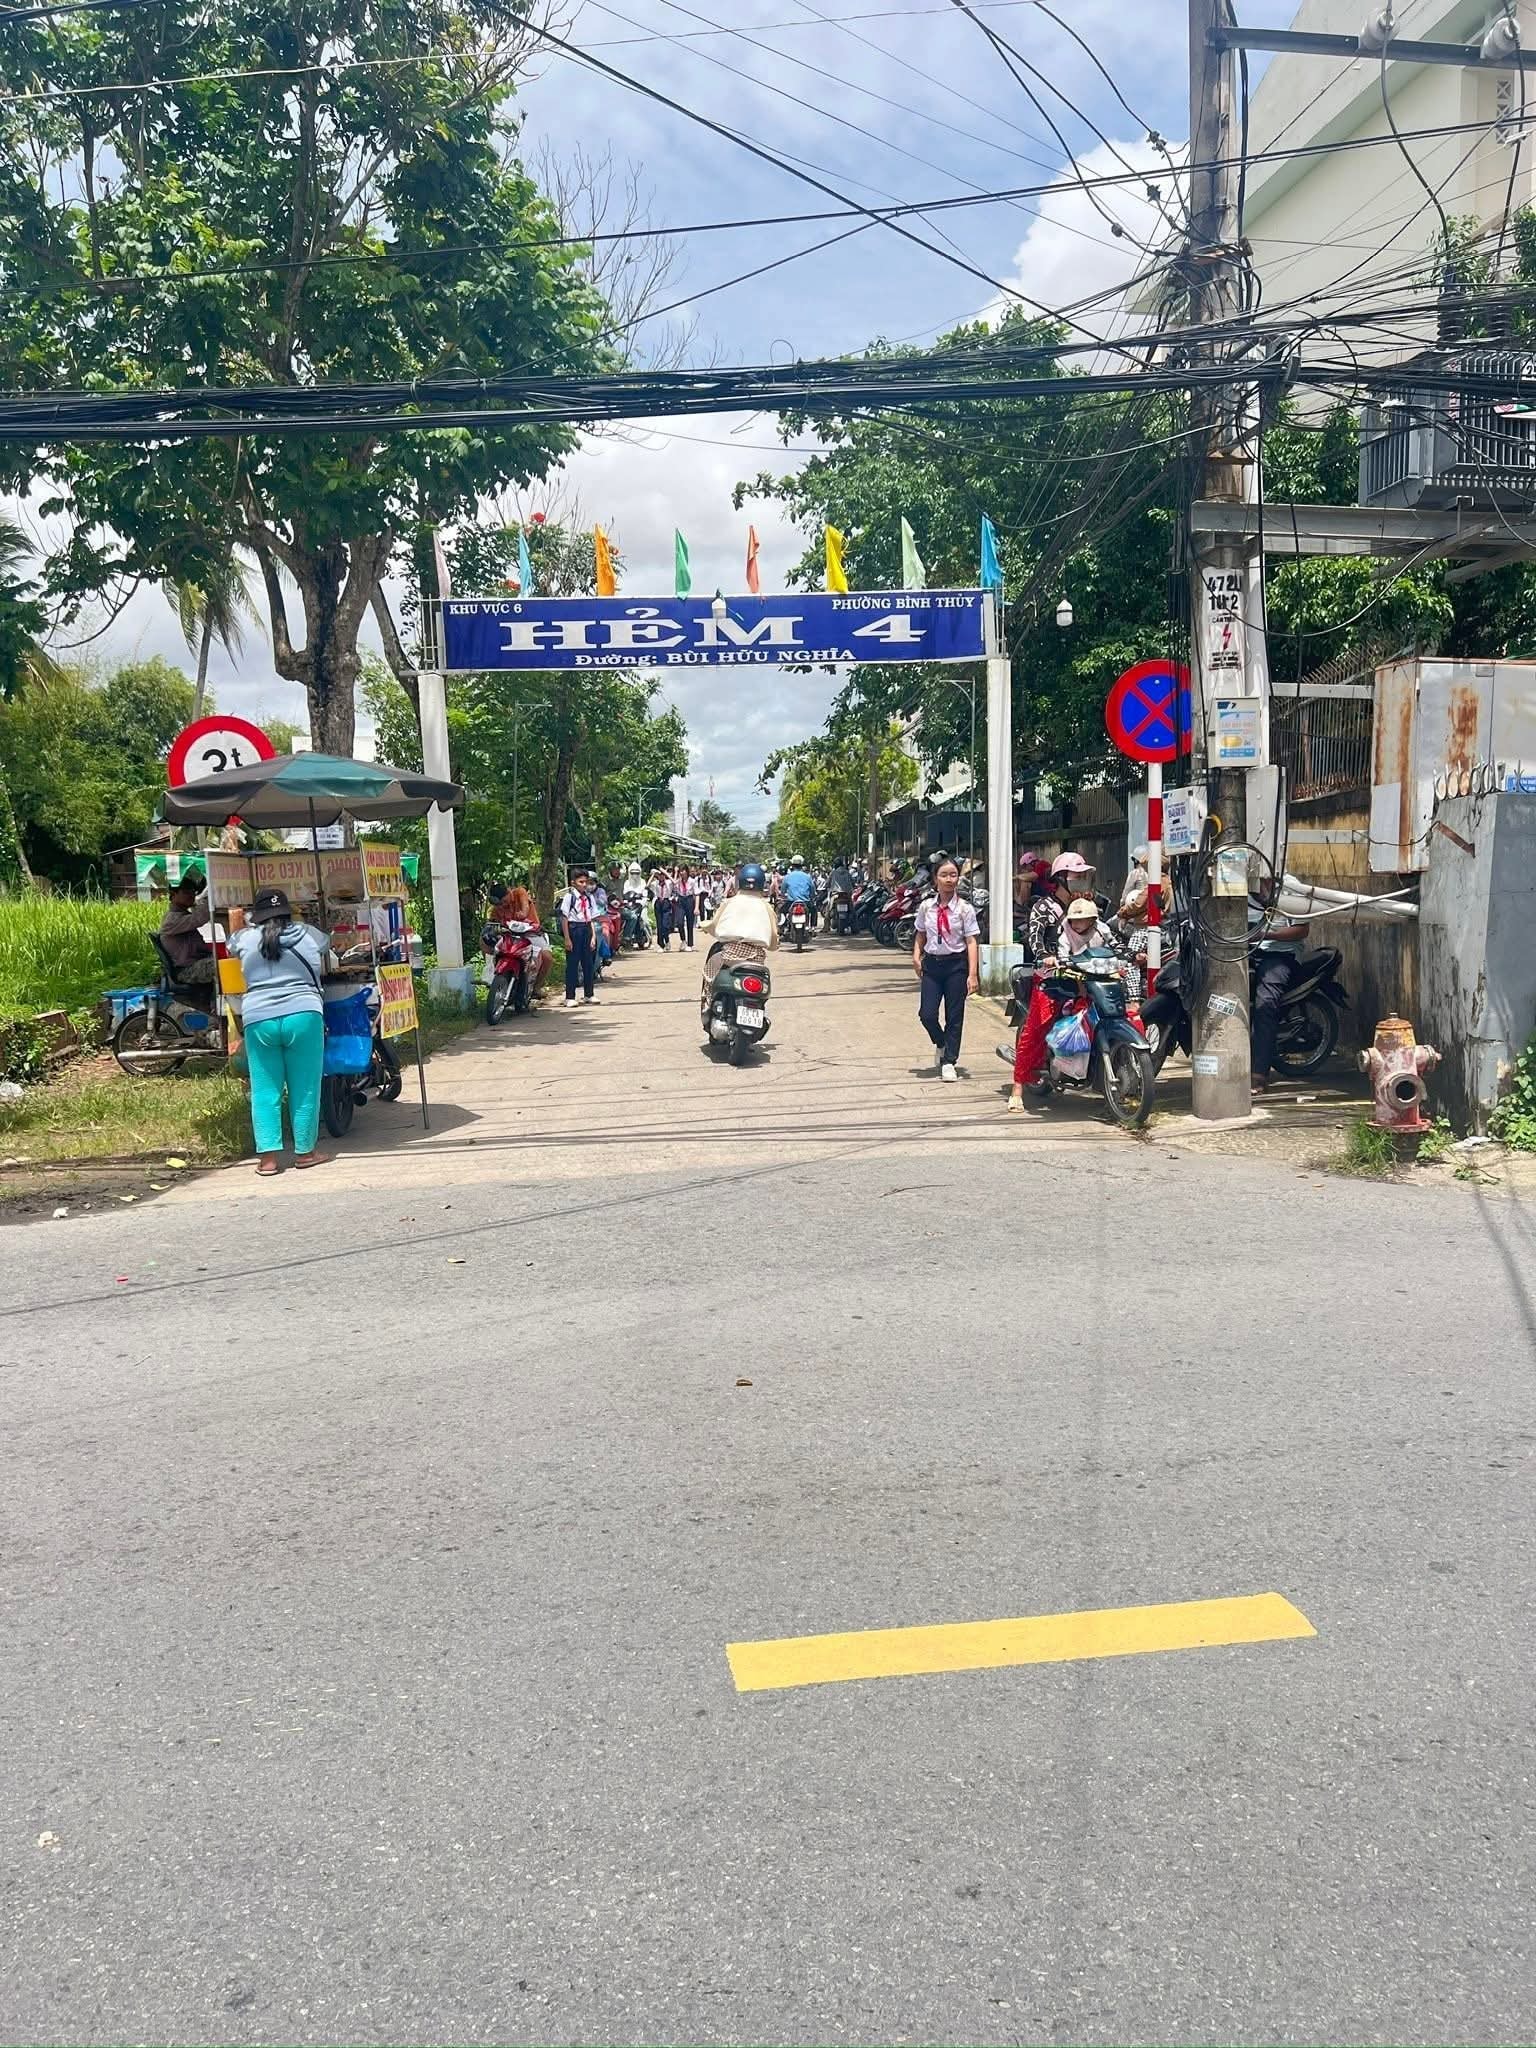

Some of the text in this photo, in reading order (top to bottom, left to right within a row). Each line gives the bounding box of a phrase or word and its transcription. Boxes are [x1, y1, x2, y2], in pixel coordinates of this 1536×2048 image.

[449, 603, 523, 617] KHU VỰC 6
[832, 593, 975, 610] PHƯỜNG BÌNH THỦY
[500, 607, 928, 651] HẺM 4
[575, 648, 856, 667] Đường: BÙI HỮU NGHĨA
